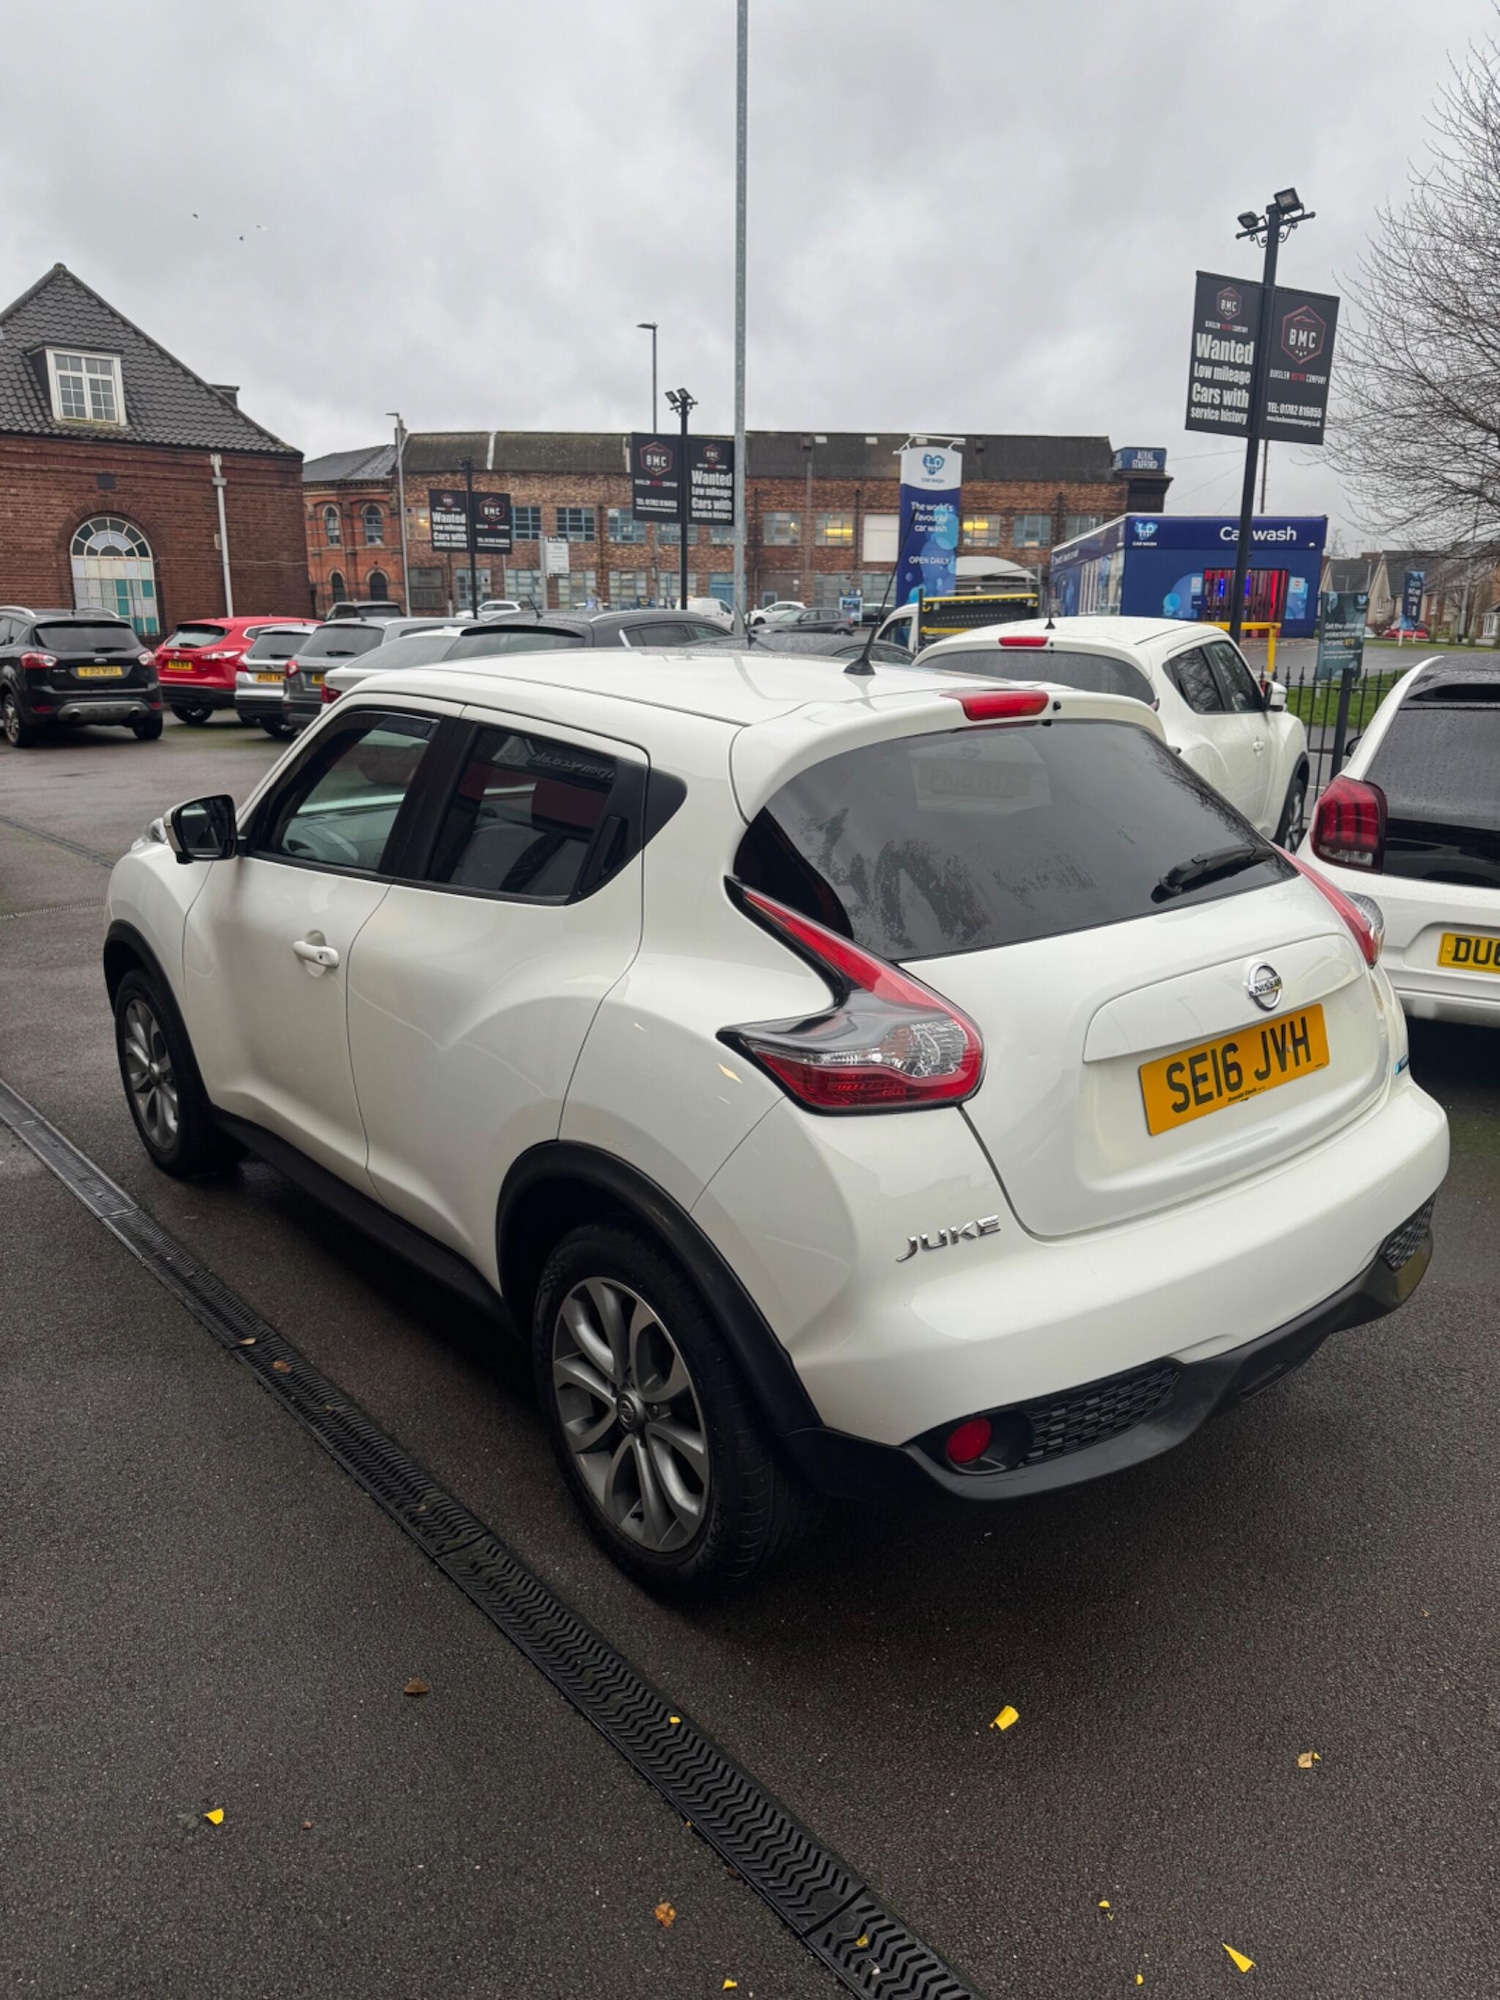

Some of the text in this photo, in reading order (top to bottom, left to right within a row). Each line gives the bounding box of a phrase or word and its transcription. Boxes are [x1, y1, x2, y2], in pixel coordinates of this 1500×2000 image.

[1220, 299, 1236, 311] BMC
[1289, 328, 1317, 349] BMC
[1196, 332, 1255, 366] Wanted
[1194, 361, 1252, 386] Low mileage
[1192, 382, 1250, 409] Cars with
[1267, 401, 1280, 413] TEL:
[1190, 406, 1219, 420] service
[1220, 408, 1248, 425] history
[646, 454, 667, 466] BMC
[691, 469, 732, 487] Wanted
[691, 485, 731, 498] Low mileage
[483, 506, 500, 515] BMC
[691, 496, 712, 510] Cars
[712, 498, 732, 511] with
[910, 500, 925, 511] The
[432, 511, 466, 523] Wanted
[433, 531, 450, 540] Cars
[914, 524, 947, 532] car wash
[1219, 525, 1297, 541] Ca wash
[908, 555, 949, 565] OPEN DAILY
[1253, 977, 1282, 994] NISSAN
[1166, 1016, 1312, 1114] SE16 JVH
[896, 1214, 1001, 1263] JUKE
